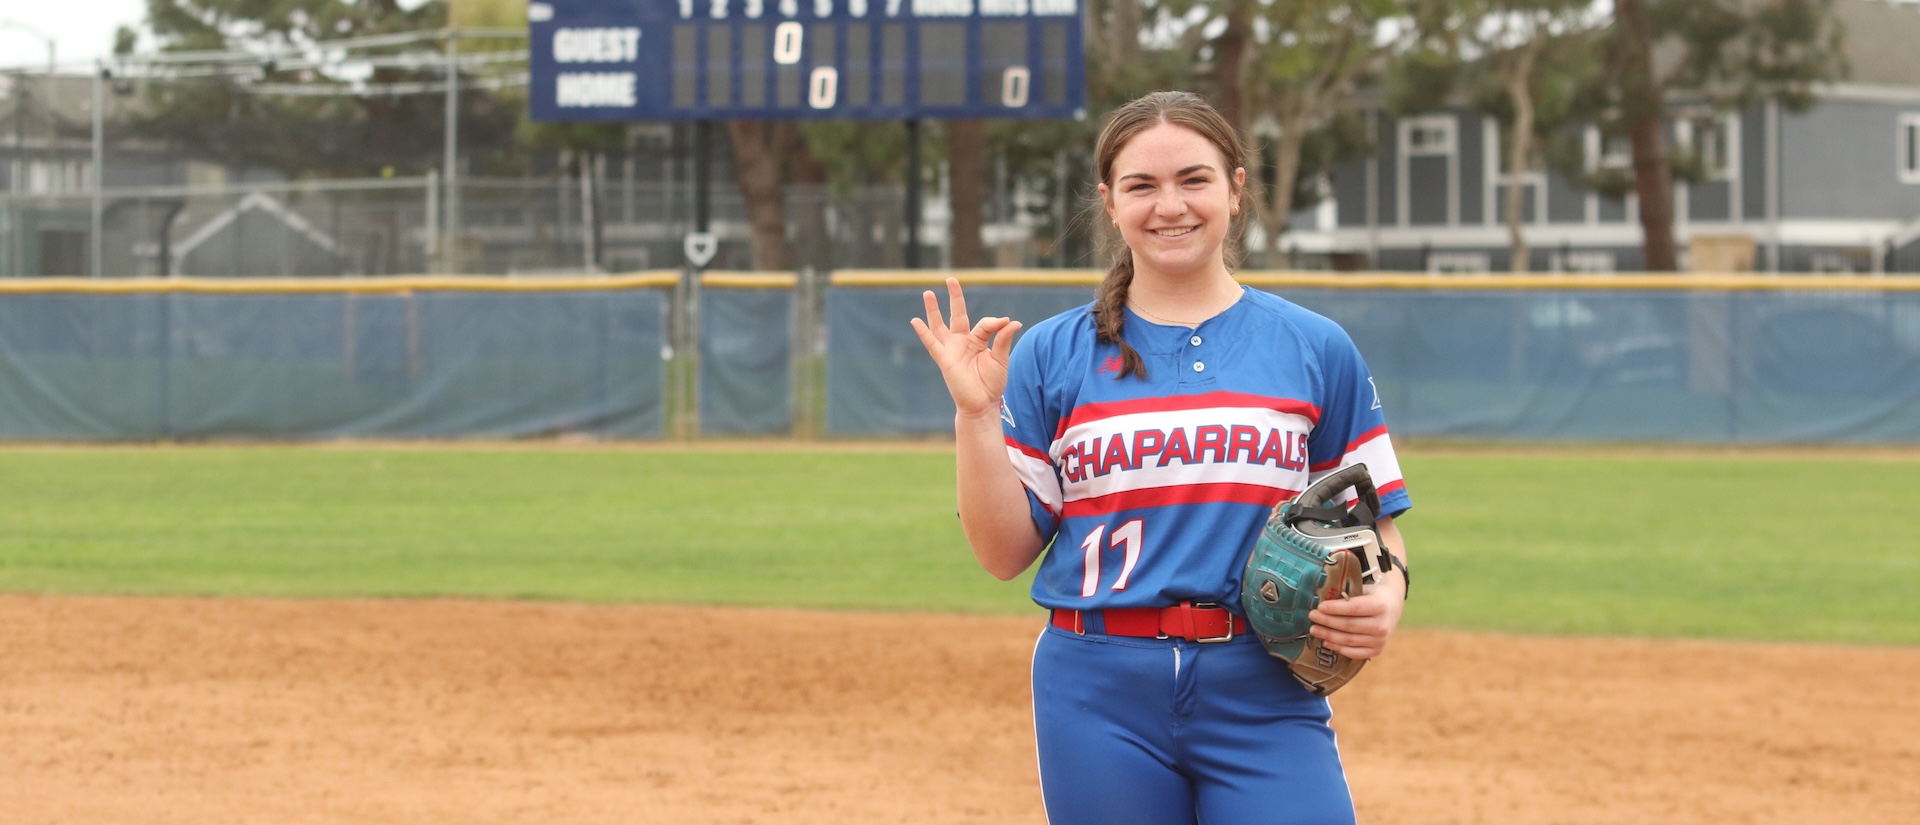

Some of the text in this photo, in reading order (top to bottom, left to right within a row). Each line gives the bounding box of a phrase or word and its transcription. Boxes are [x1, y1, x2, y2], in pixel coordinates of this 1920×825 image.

[553, 27, 641, 63] GUEST
[774, 21, 803, 64] 0
[556, 72, 638, 108] HOME
[809, 67, 838, 109] 0
[1002, 66, 1030, 108] 0
[1061, 424, 1307, 483] CHAPARRALS
